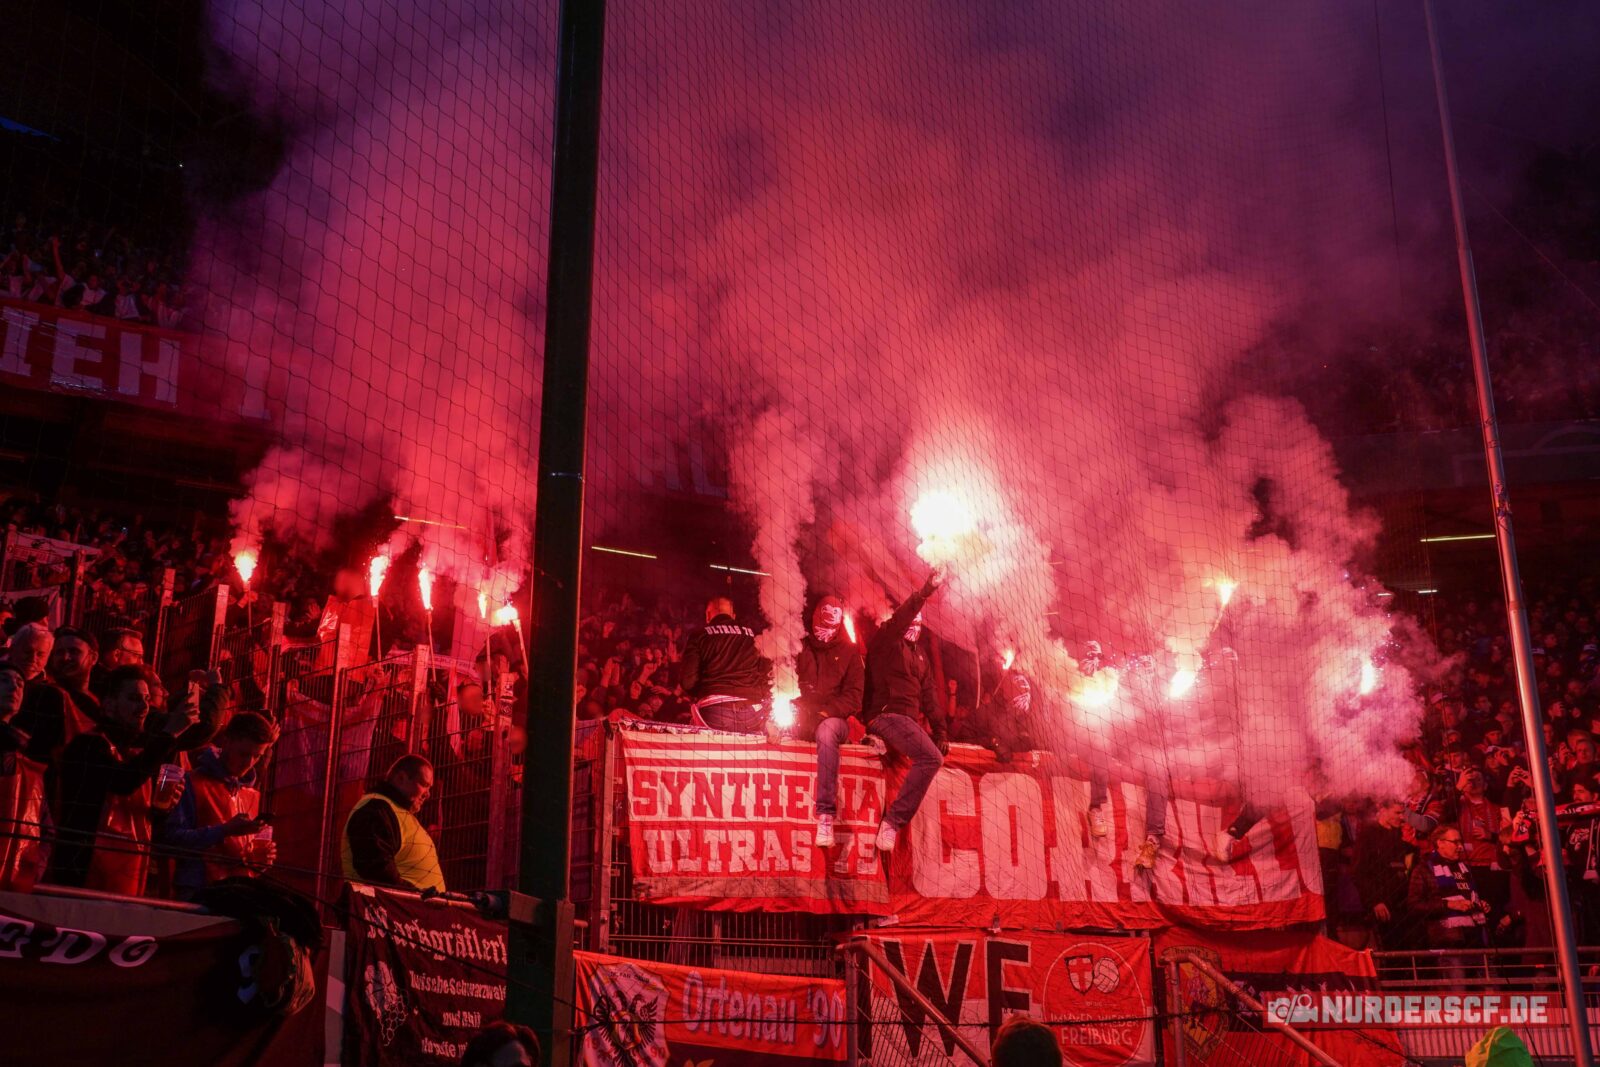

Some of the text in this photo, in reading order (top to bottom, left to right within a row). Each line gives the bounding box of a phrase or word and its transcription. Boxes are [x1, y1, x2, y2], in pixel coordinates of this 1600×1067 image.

[704, 625, 741, 635] ULTRAS
[631, 768, 880, 823] SYNTHEIA
[642, 829, 812, 873] ULTRAS
[682, 970, 797, 1042] Ortenau
[1061, 1027, 1133, 1046] FREIBURG
